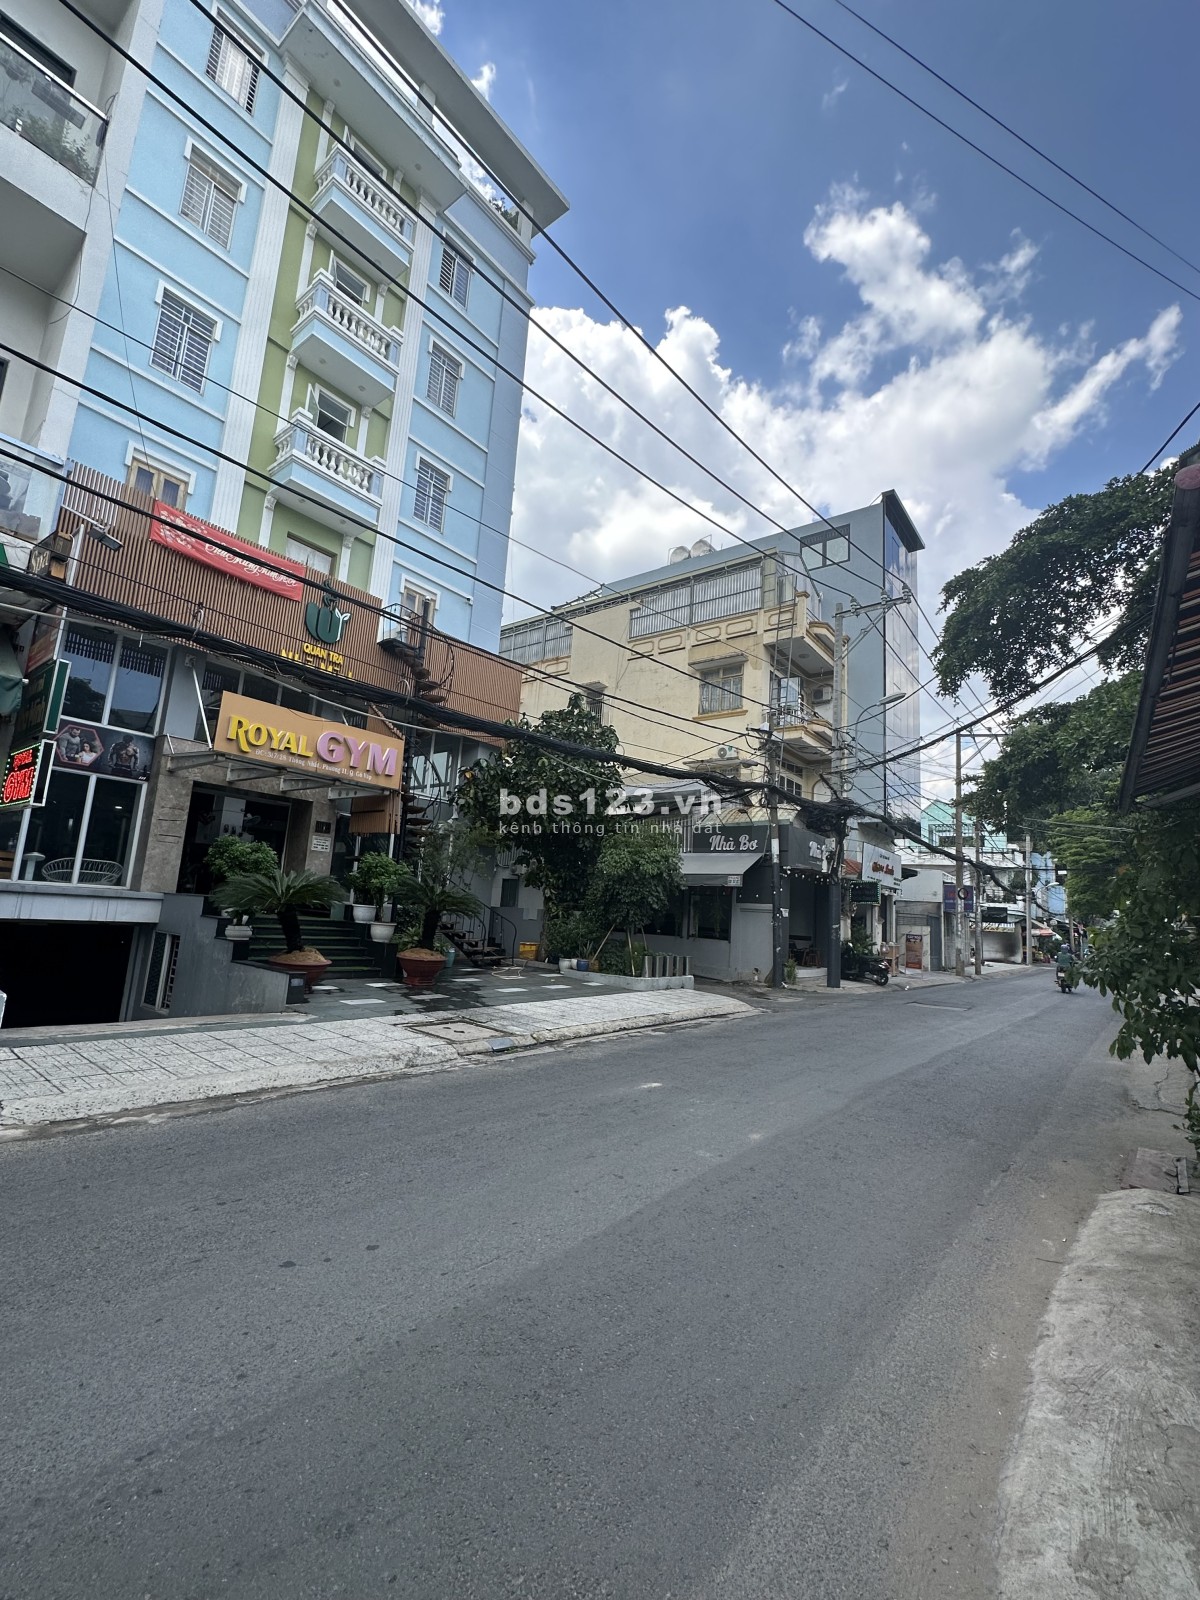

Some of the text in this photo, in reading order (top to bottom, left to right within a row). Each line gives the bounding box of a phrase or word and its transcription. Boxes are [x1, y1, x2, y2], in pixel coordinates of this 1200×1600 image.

[226, 715, 398, 776] ROYAL GYM
[709, 834, 759, 851] Nhà Bơ
